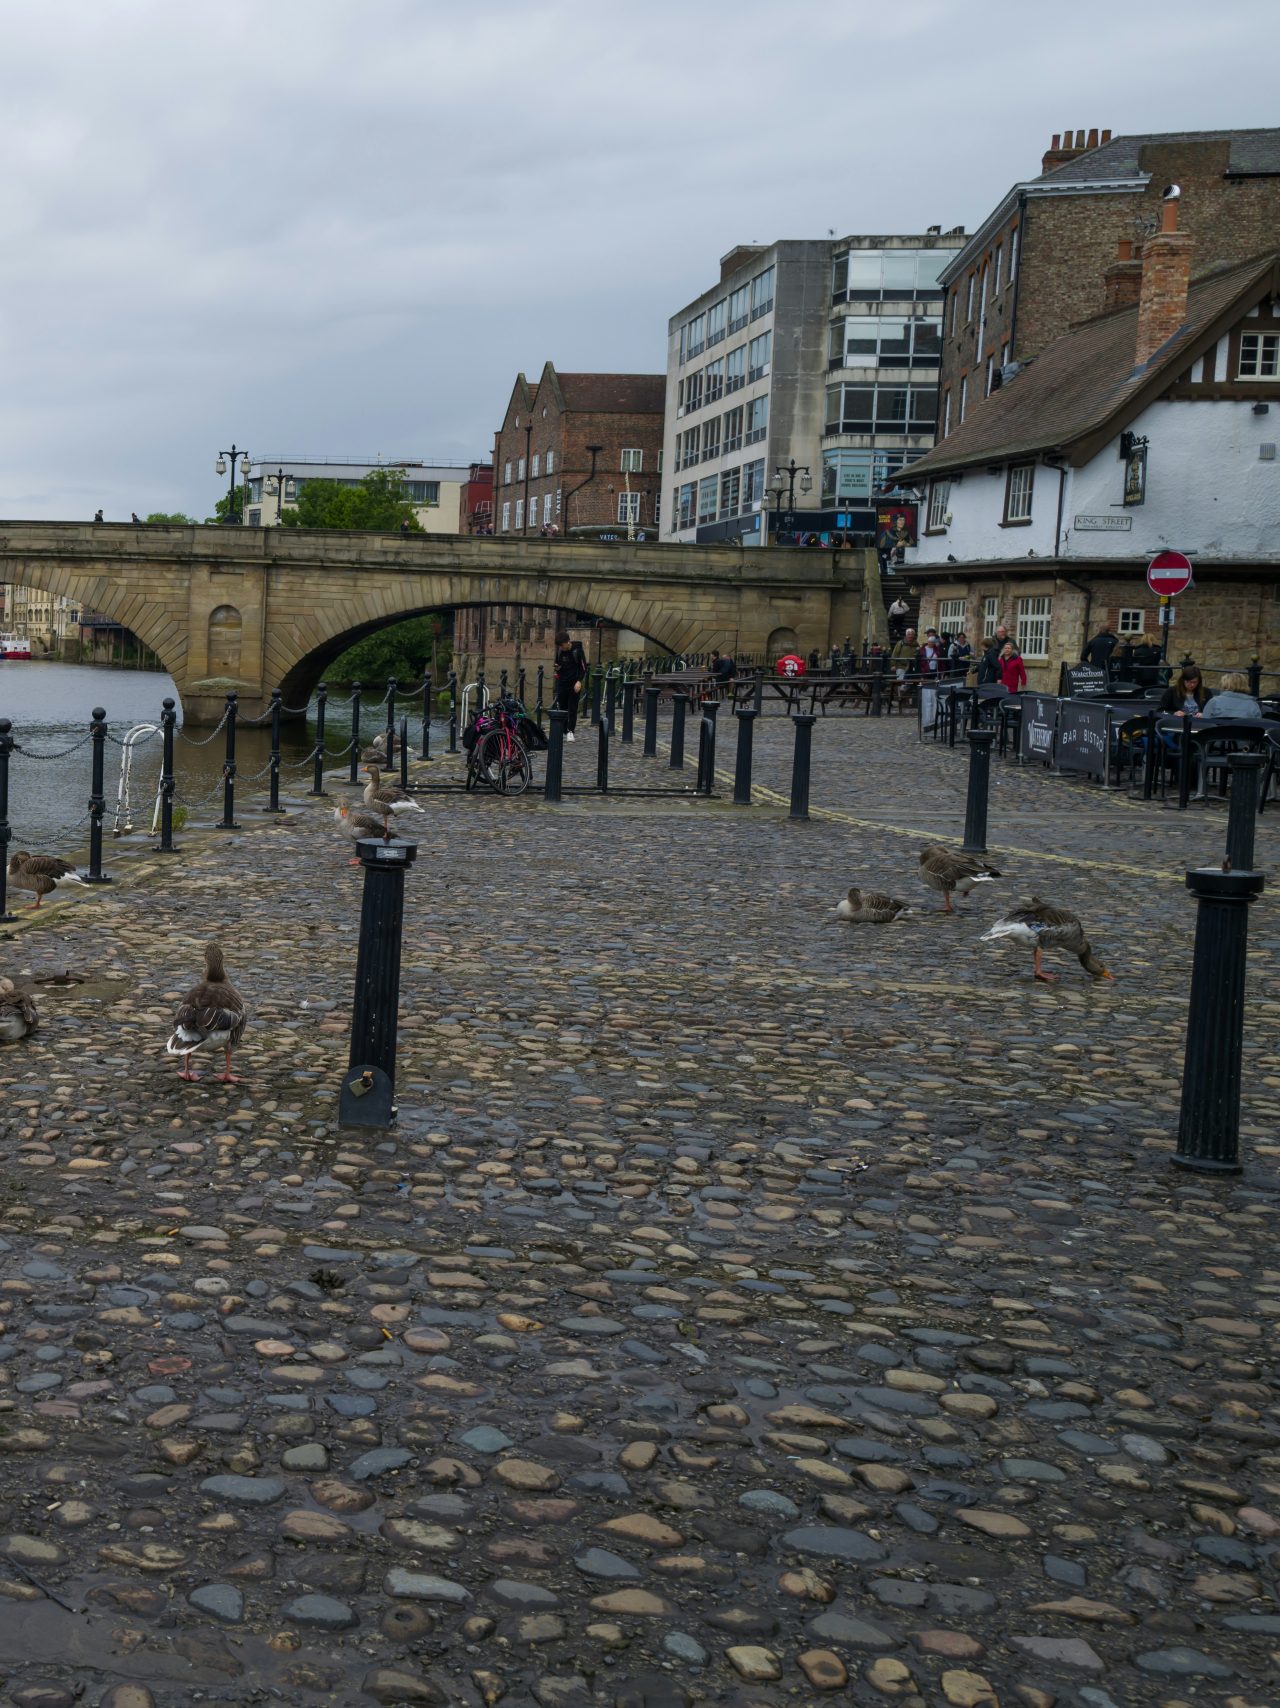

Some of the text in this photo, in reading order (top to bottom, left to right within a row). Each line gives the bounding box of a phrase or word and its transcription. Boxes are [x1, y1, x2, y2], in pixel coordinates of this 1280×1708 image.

[1102, 518, 1129, 526] STREET
[1028, 720, 1052, 748] WATERFRONT
[1063, 730, 1077, 744] BAR
[1084, 729, 1104, 752] BISTRO
